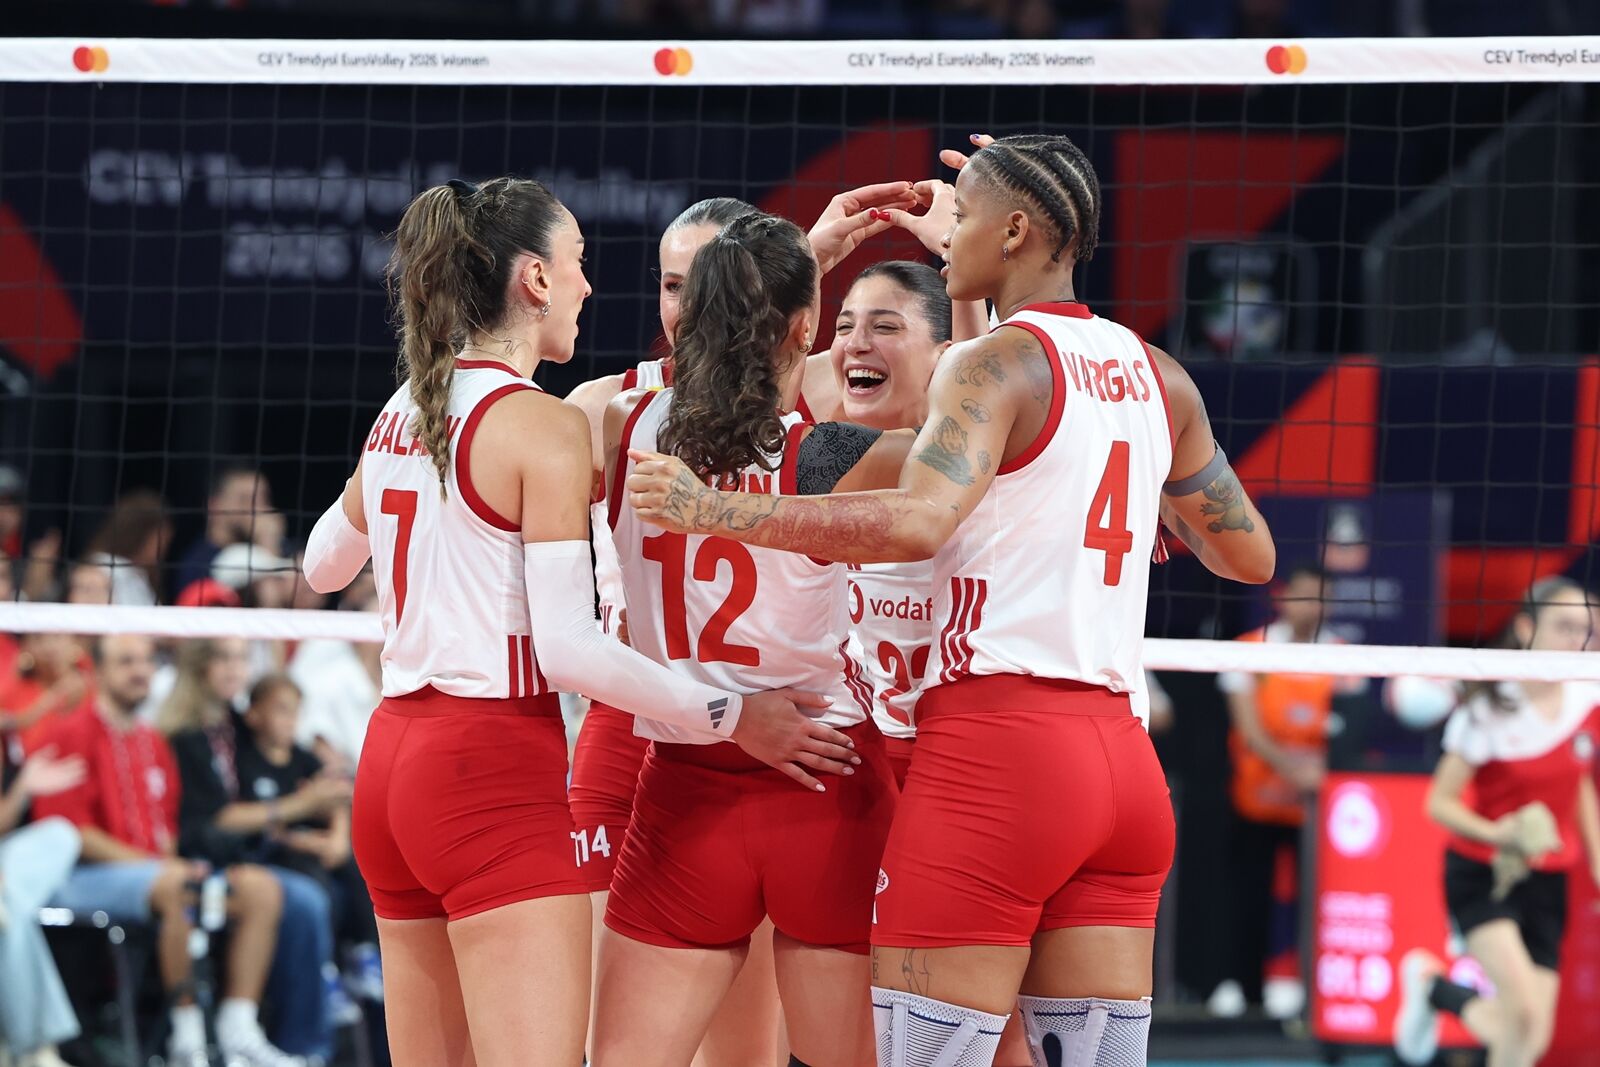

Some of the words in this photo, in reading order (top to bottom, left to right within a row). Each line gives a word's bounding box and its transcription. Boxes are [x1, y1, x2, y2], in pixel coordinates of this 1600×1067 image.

[257, 52, 284, 67] CEV
[287, 51, 338, 69] Trendyol
[341, 52, 405, 69] EuroVolley
[409, 53, 438, 67] 2026
[442, 53, 490, 67] Women
[848, 52, 875, 67] CEV
[879, 51, 933, 69] Trendyol
[938, 52, 1005, 69] EuroVolley
[1009, 52, 1041, 67] 2026
[1045, 52, 1096, 67] Women
[1484, 50, 1513, 64] CEV
[1517, 49, 1577, 68] Trendyol
[1062, 351, 1151, 402] VARGAS
[1083, 440, 1133, 587] 4
[381, 488, 418, 630] 7
[642, 529, 760, 667] 12
